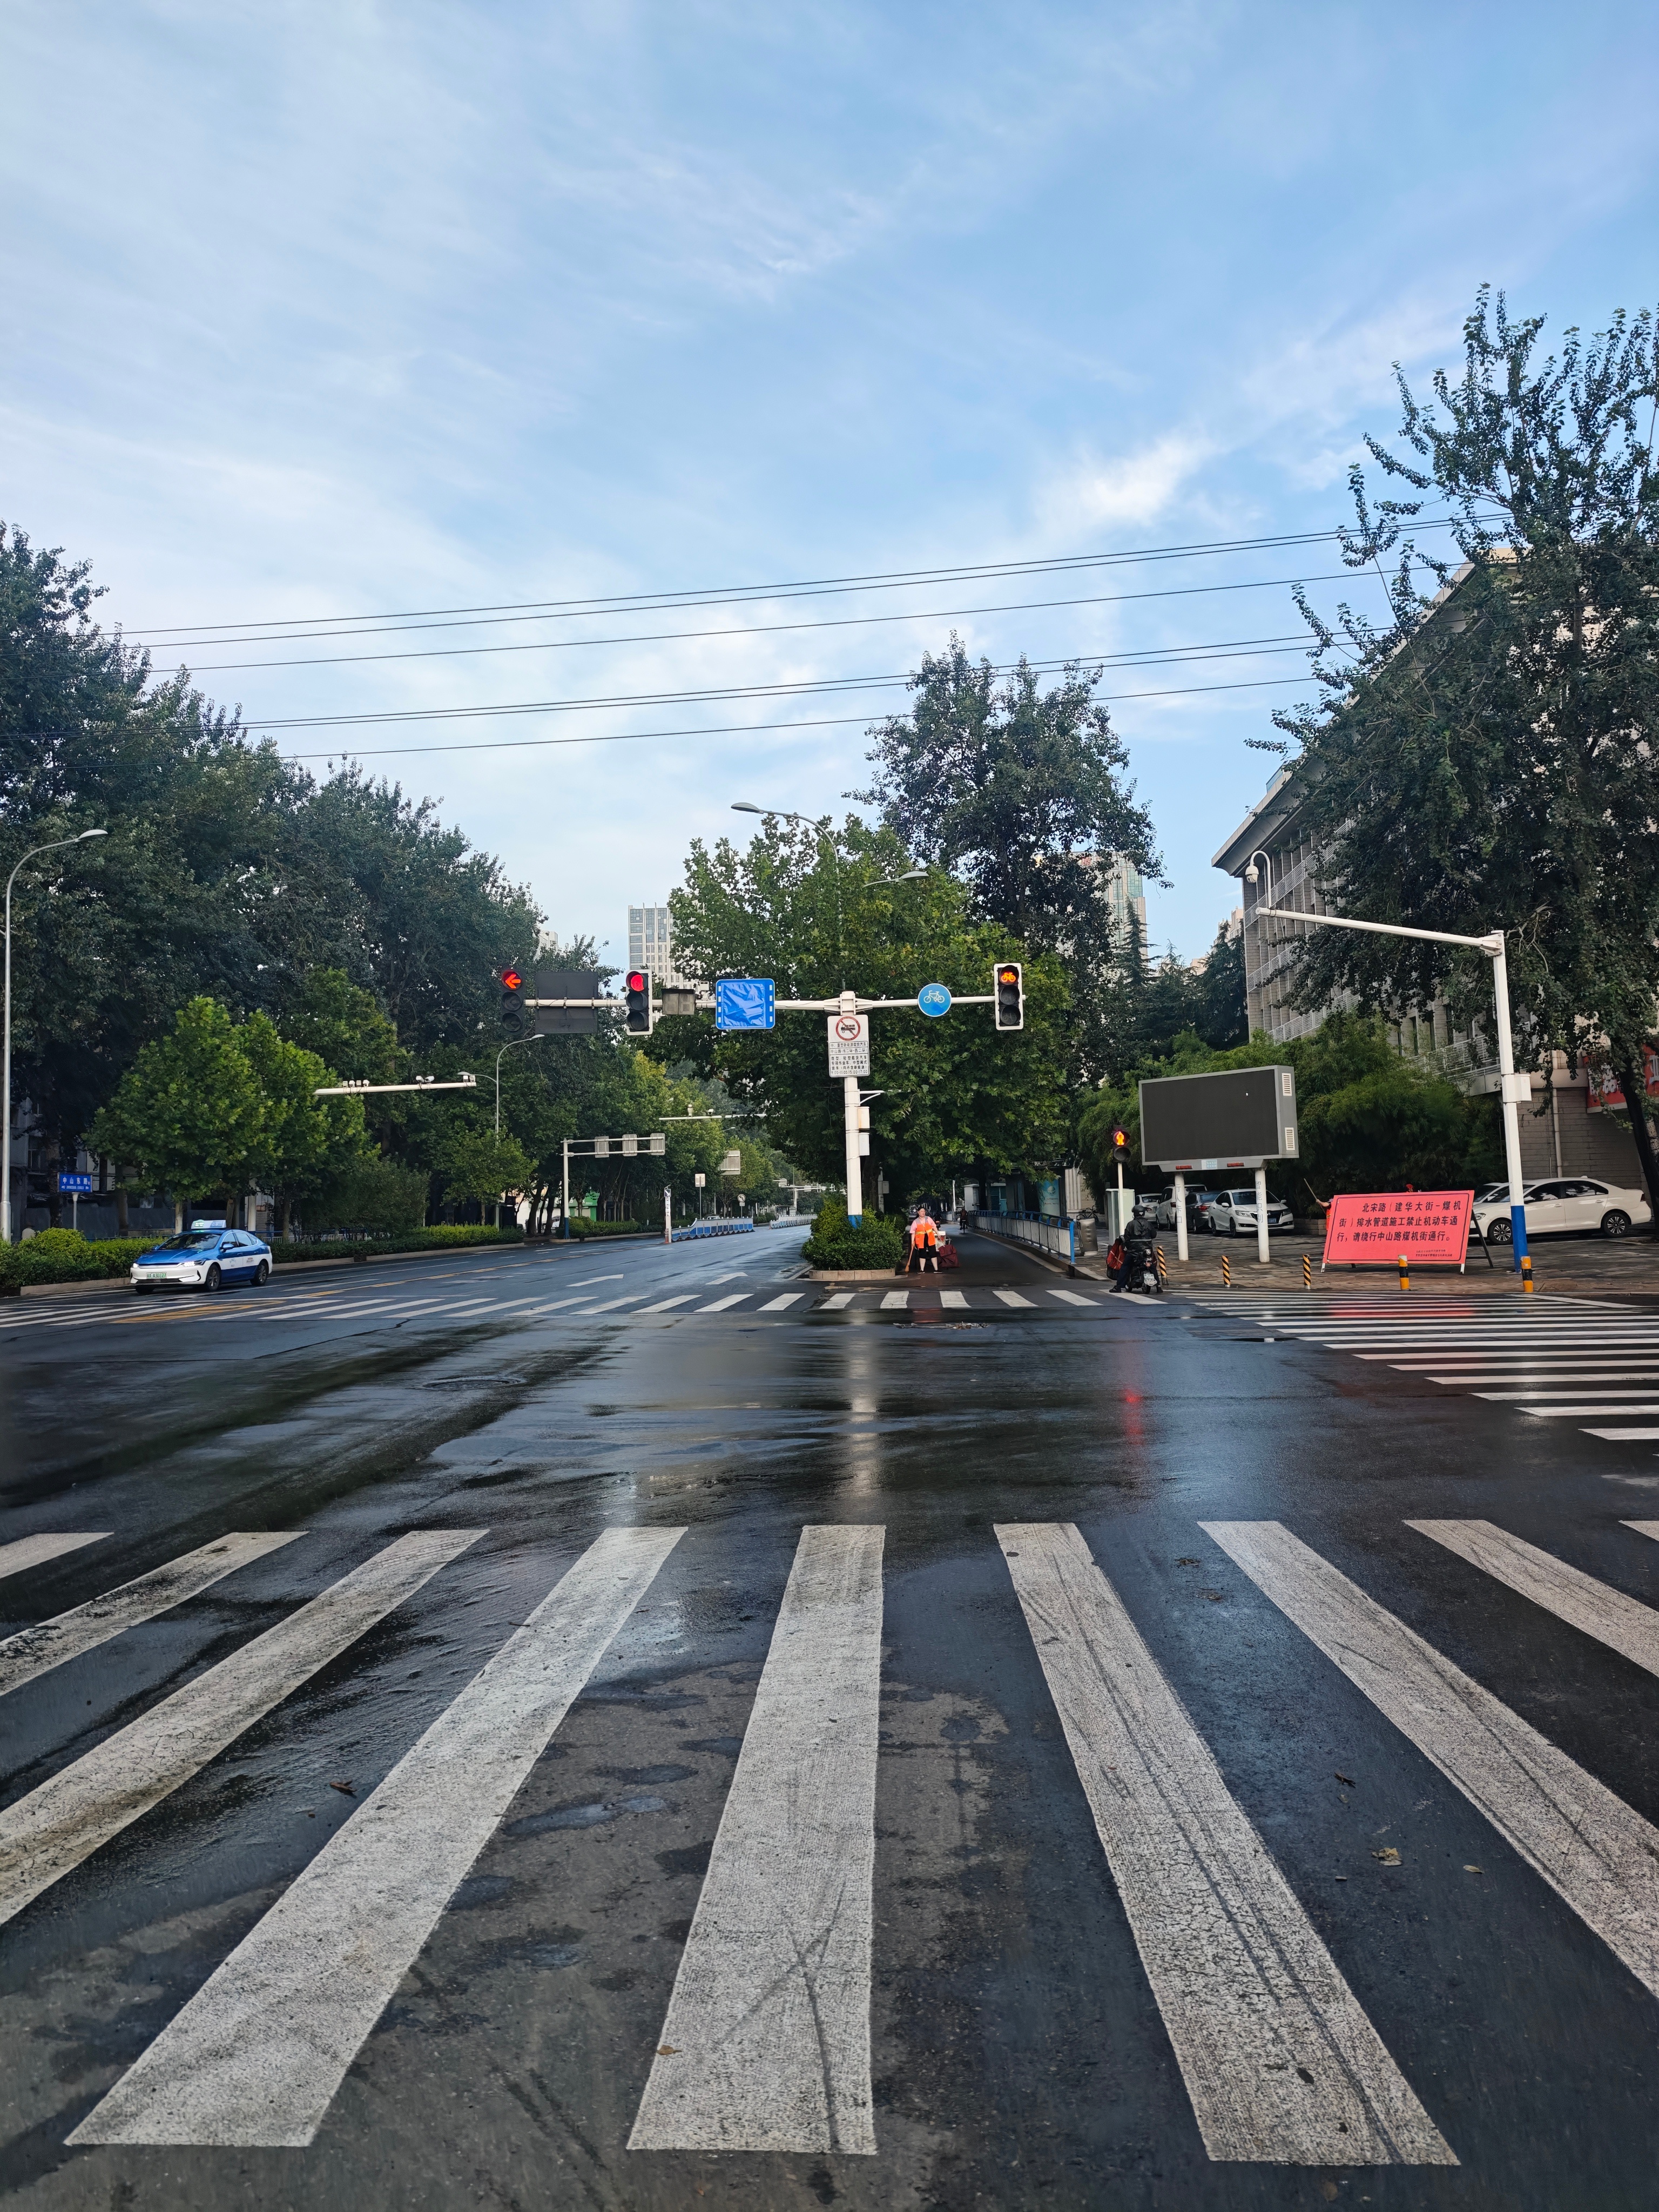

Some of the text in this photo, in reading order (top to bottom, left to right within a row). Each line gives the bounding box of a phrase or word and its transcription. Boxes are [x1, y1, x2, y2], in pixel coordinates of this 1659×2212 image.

[63, 1176, 87, 1185] 中山东路
[1339, 1215, 1458, 1228] 街）排水管道施工禁止机动车通
[1337, 1231, 1450, 1242] 行，请绕行中山路煤机街通行。
